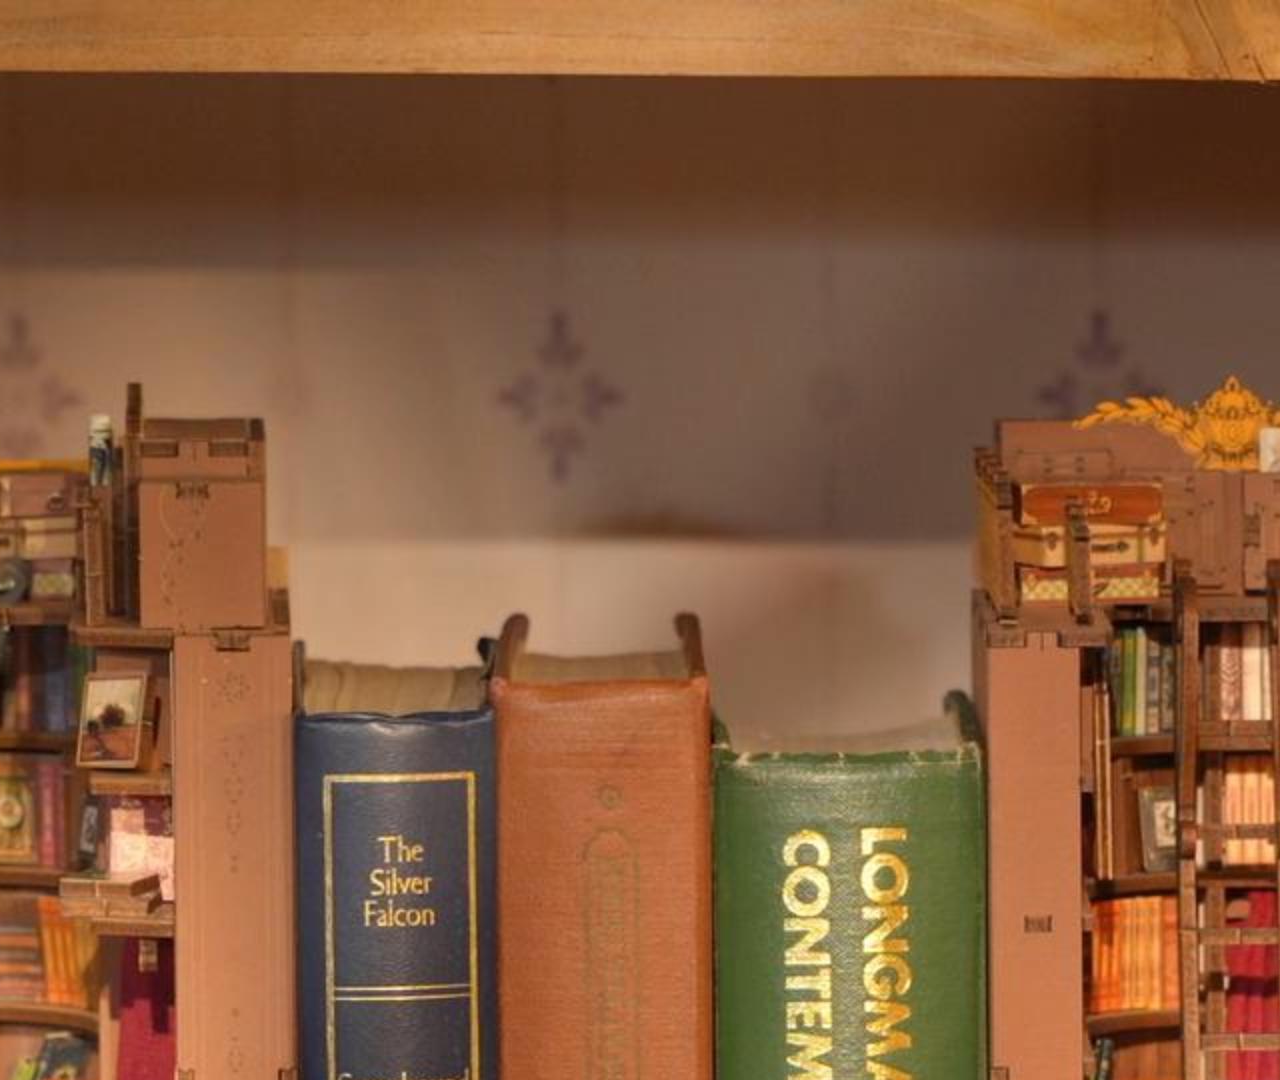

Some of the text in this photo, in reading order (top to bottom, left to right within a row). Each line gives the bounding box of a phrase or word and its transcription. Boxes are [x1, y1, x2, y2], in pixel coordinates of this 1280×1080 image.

[377, 835, 424, 864] The
[370, 868, 432, 897] Silver
[363, 899, 436, 928] Falcon
